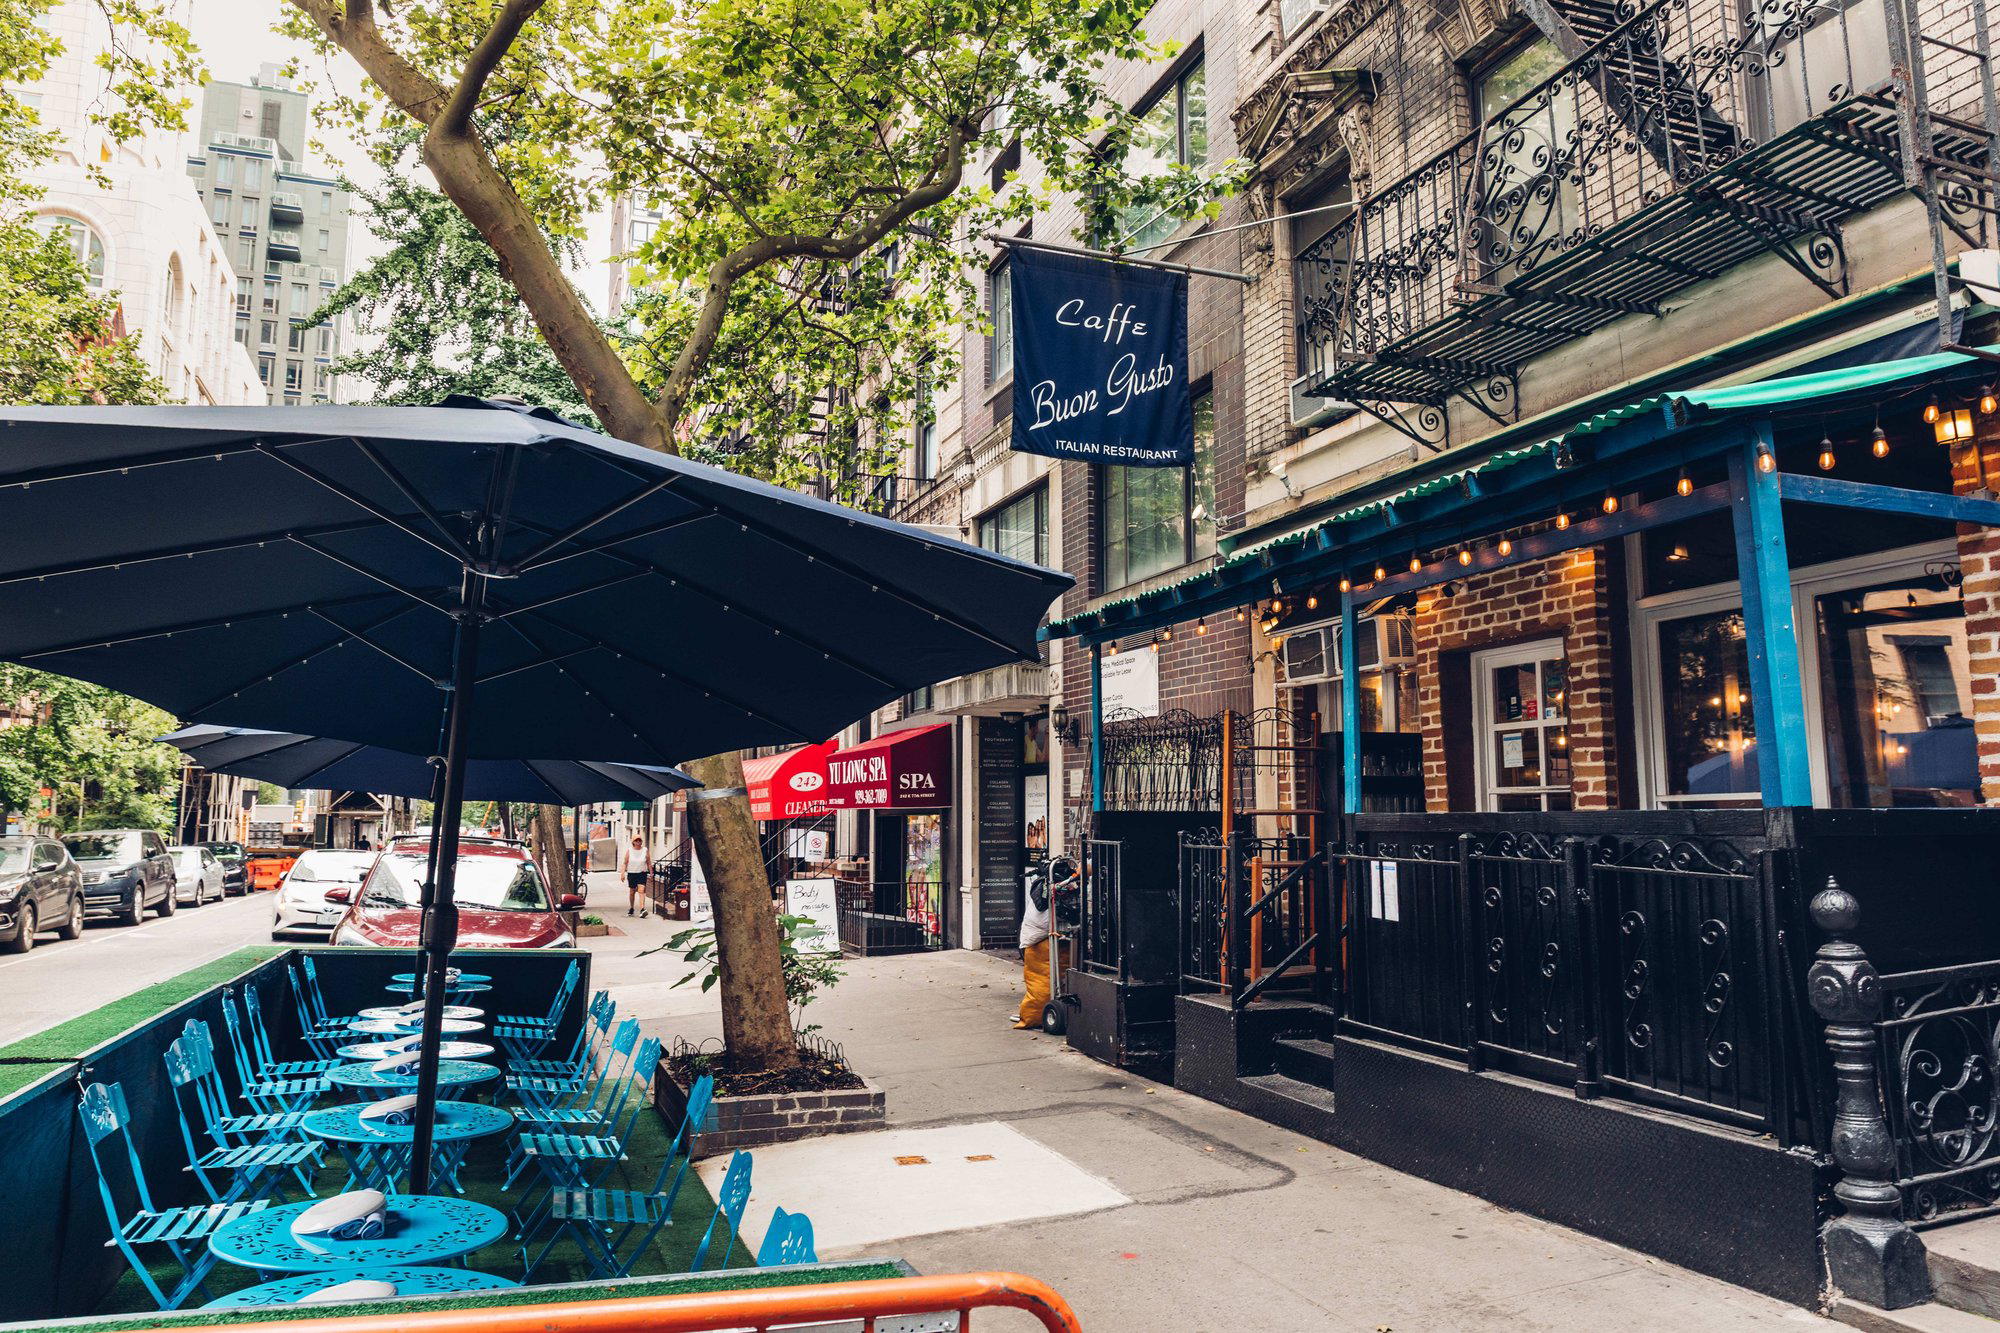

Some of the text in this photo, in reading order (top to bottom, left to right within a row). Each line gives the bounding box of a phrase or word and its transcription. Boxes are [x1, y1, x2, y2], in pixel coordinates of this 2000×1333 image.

[1056, 299, 1148, 344] Caffe
[1029, 353, 1174, 431] Buon Gusto
[1055, 440, 1178, 460] ITALIAN RESTAURANT
[797, 776, 817, 788] 242
[829, 756, 887, 785] YU LONG SPA
[899, 772, 936, 790] SPA
